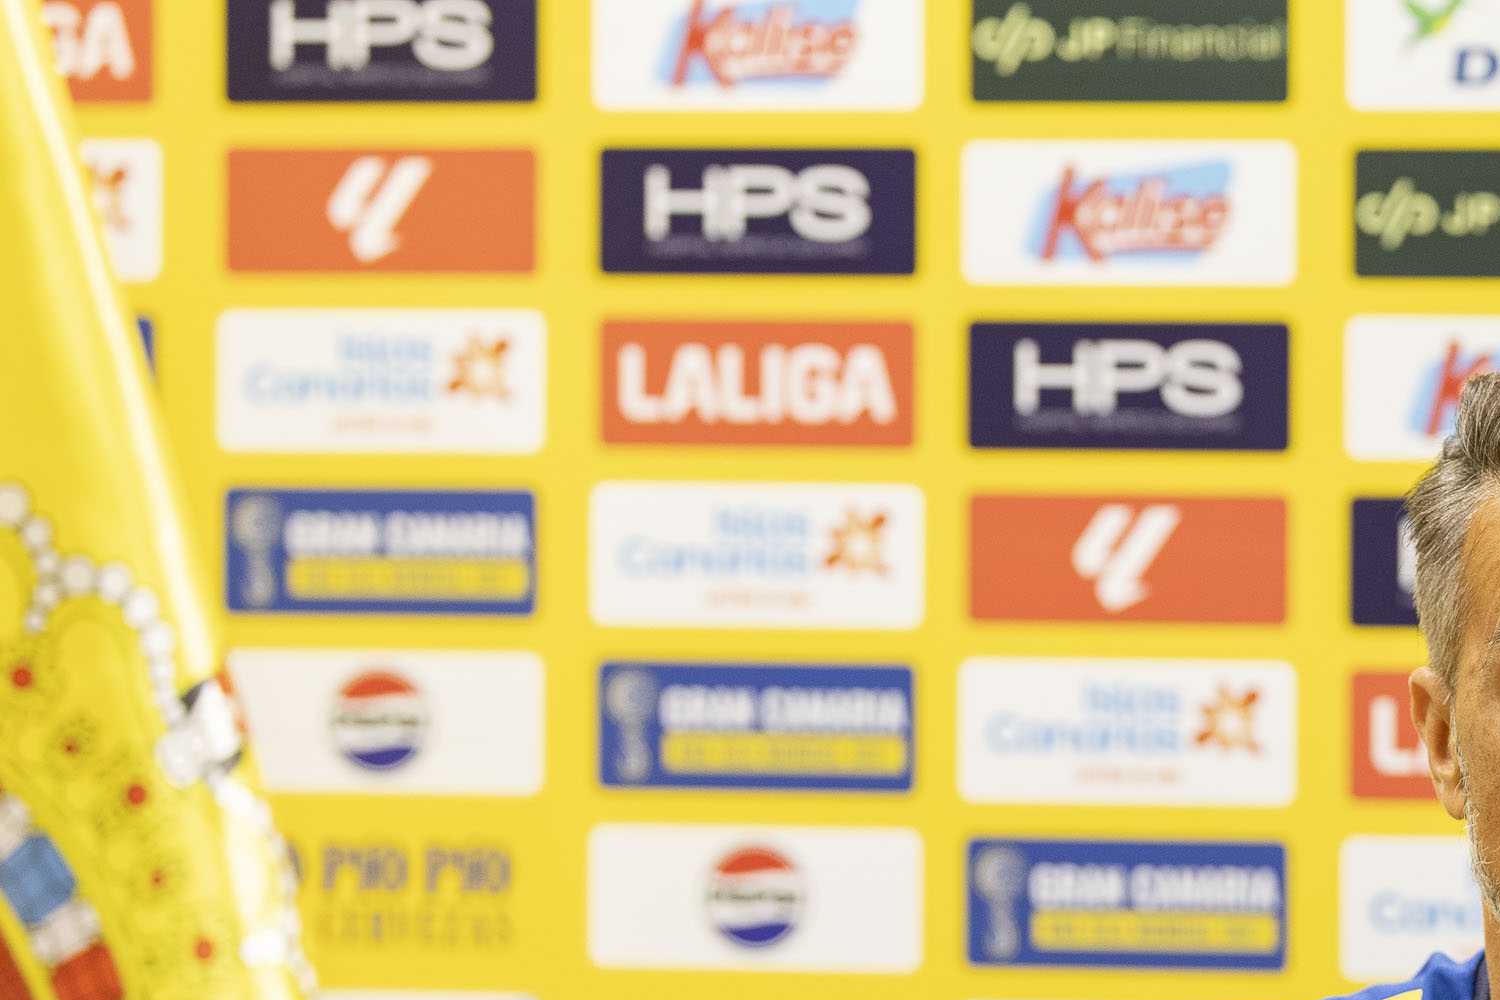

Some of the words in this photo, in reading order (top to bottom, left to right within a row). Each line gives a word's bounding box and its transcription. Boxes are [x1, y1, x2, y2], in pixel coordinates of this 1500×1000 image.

[268, 0, 494, 71] HPS
[643, 163, 872, 242] HPS
[1036, 160, 1232, 266] Kalise
[616, 342, 898, 425] LALIGA
[1012, 338, 1244, 417] HPS
